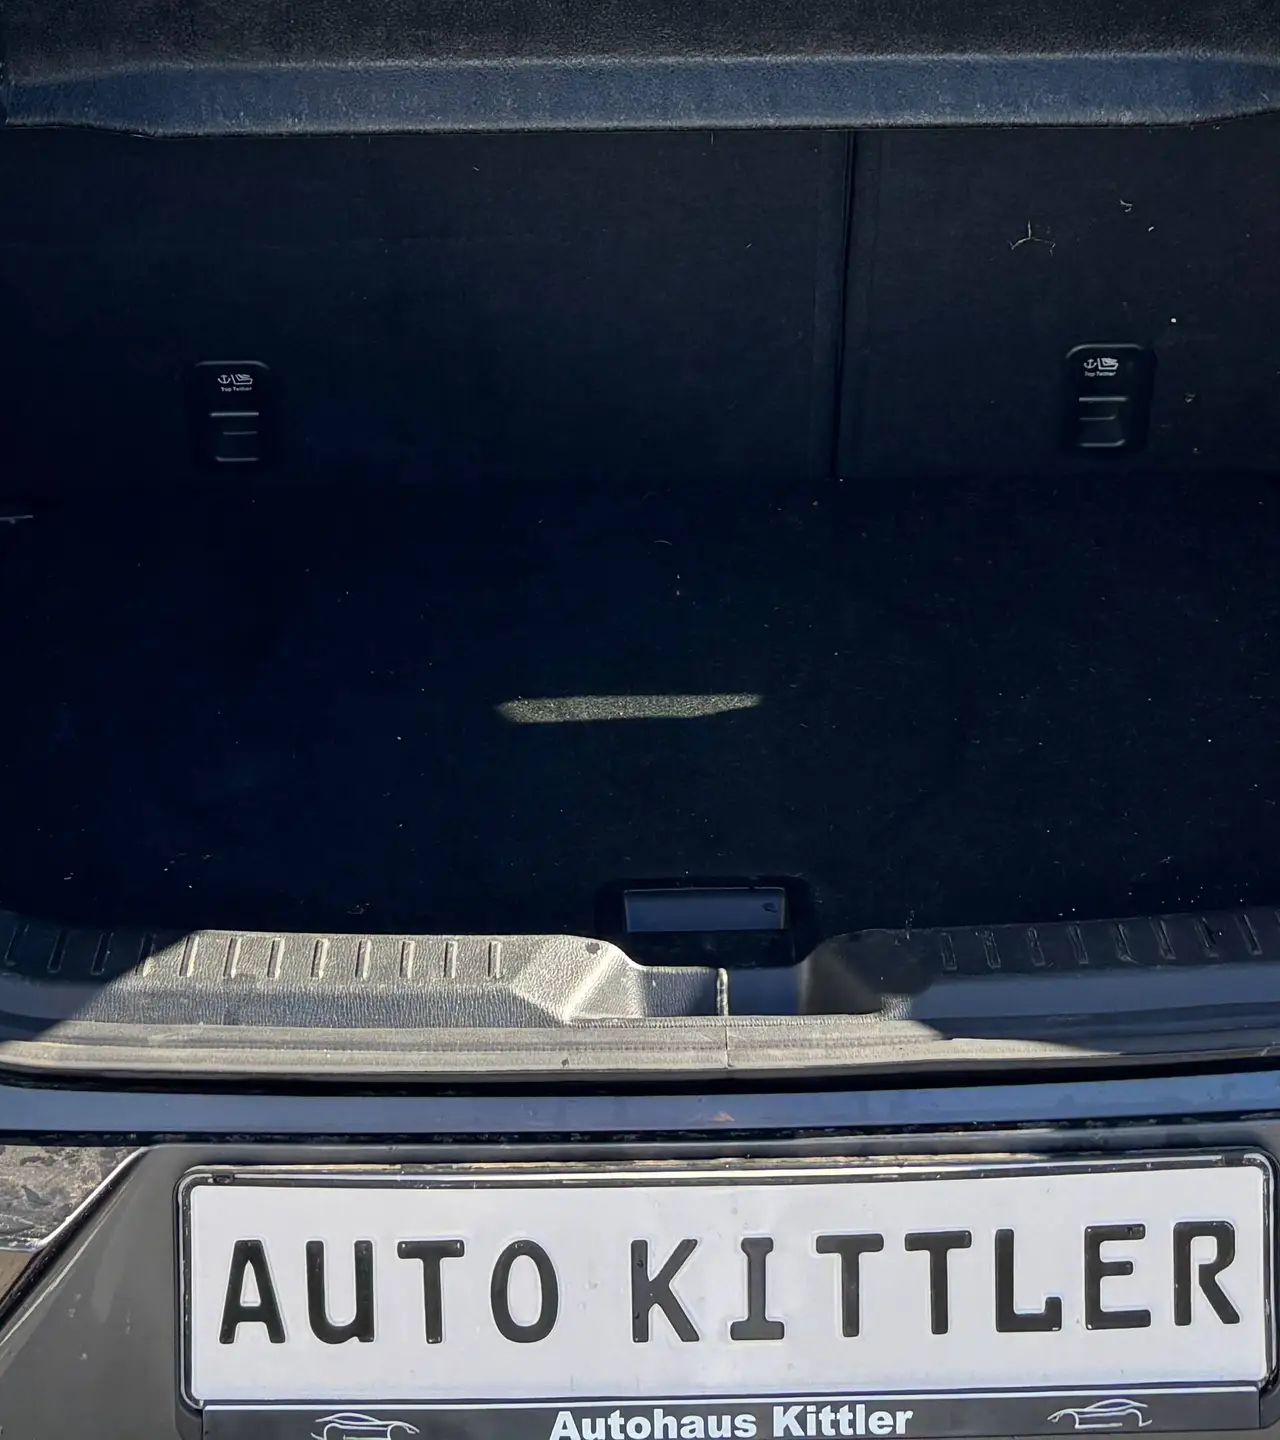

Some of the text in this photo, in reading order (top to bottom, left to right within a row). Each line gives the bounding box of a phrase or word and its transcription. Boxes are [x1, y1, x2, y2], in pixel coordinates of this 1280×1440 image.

[219, 1220, 1241, 1345] AUTO KITTLER
[549, 1403, 914, 1440] Autohaus Kittler
